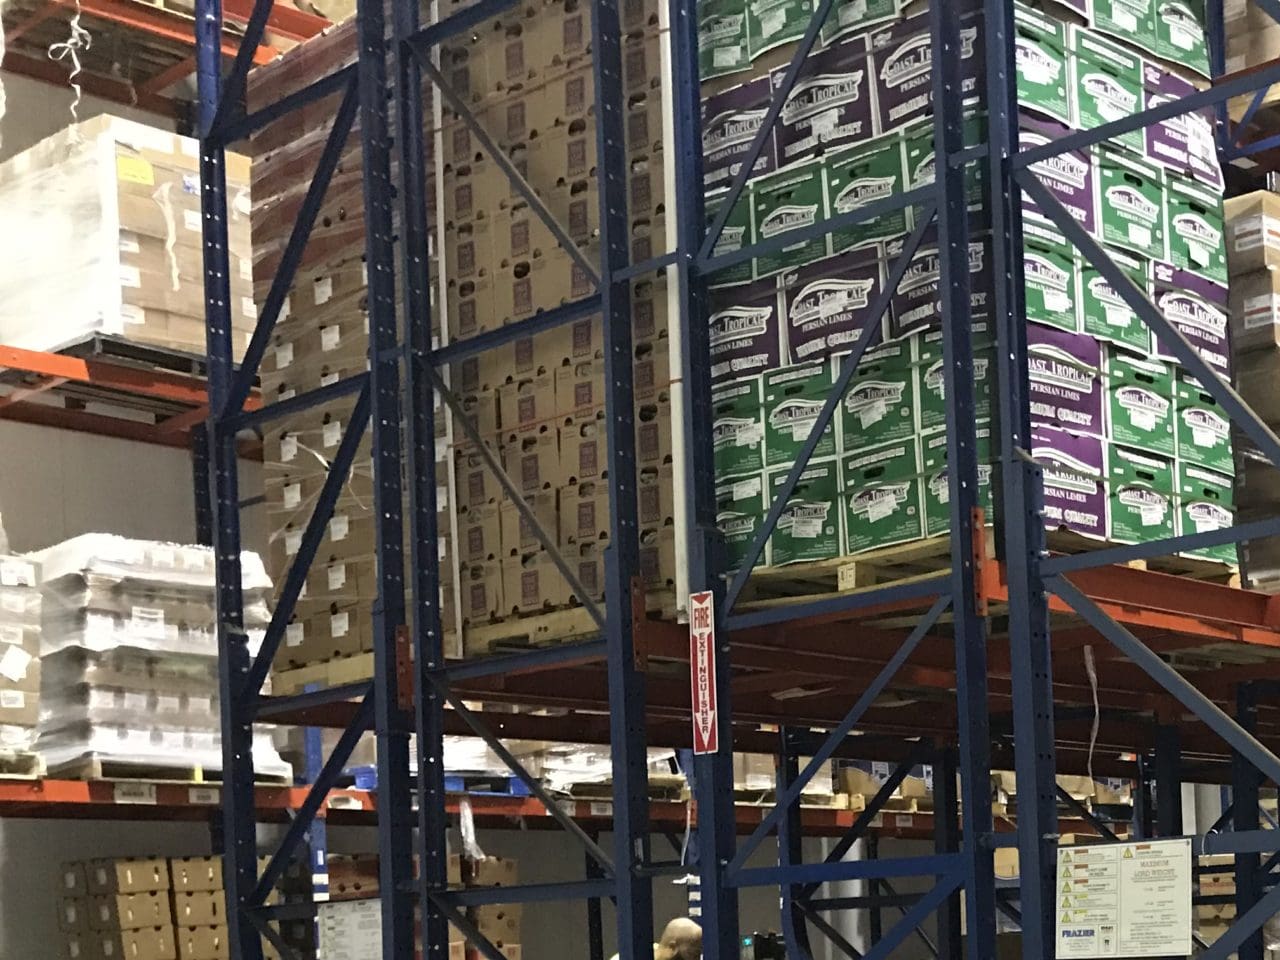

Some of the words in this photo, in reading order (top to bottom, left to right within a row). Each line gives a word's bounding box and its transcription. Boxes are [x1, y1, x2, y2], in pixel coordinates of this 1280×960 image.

[810, 80, 857, 105] TROPICAL
[1168, 299, 1191, 315] COAST
[723, 314, 765, 333] TROPICAL
[1052, 360, 1091, 383] TROPICAL
[1030, 382, 1060, 396] PERSIAN
[1060, 389, 1080, 401] LIMES
[1044, 487, 1065, 498] RSIAN
[1066, 491, 1087, 503] LIMES
[694, 606, 710, 629] FIRE
[699, 632, 708, 734] EXTINGUISHER
[1062, 929, 1095, 938] FRAZIER
